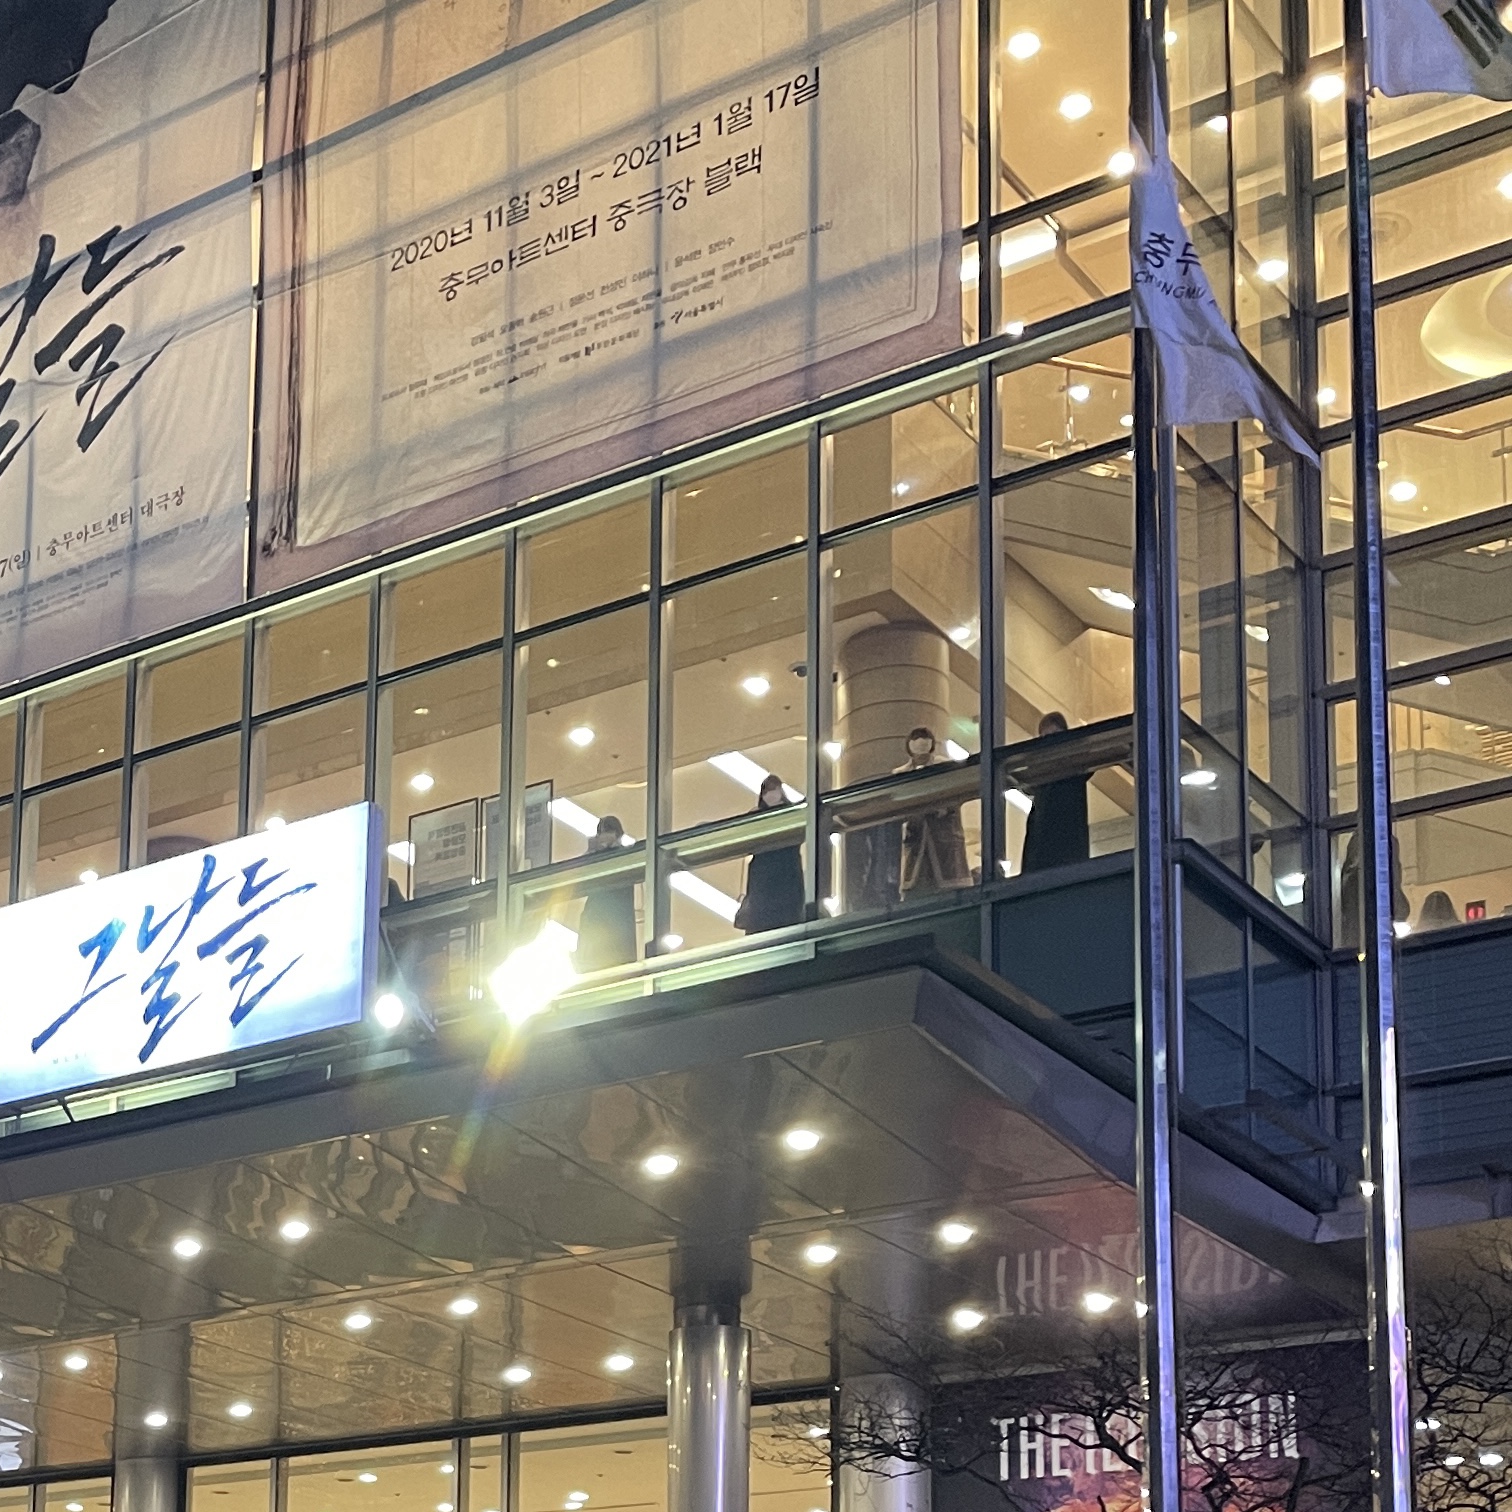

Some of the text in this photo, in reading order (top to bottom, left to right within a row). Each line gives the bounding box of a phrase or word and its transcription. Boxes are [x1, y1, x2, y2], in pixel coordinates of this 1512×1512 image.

[391, 217, 473, 271] 2020년
[484, 191, 530, 231] 11월
[540, 169, 580, 207] 3일
[613, 121, 701, 175] 2021년
[715, 97, 753, 135] 1월
[764, 66, 821, 113] 17일
[438, 215, 598, 302] 충무아트센터
[607, 177, 695, 231] 중극장
[704, 145, 764, 196] 블랙
[45, 505, 134, 557] 충무아트센터
[140, 486, 186, 518] 대극장
[31, 854, 318, 1063] 그날들
[991, 1412, 1072, 1481] THE
